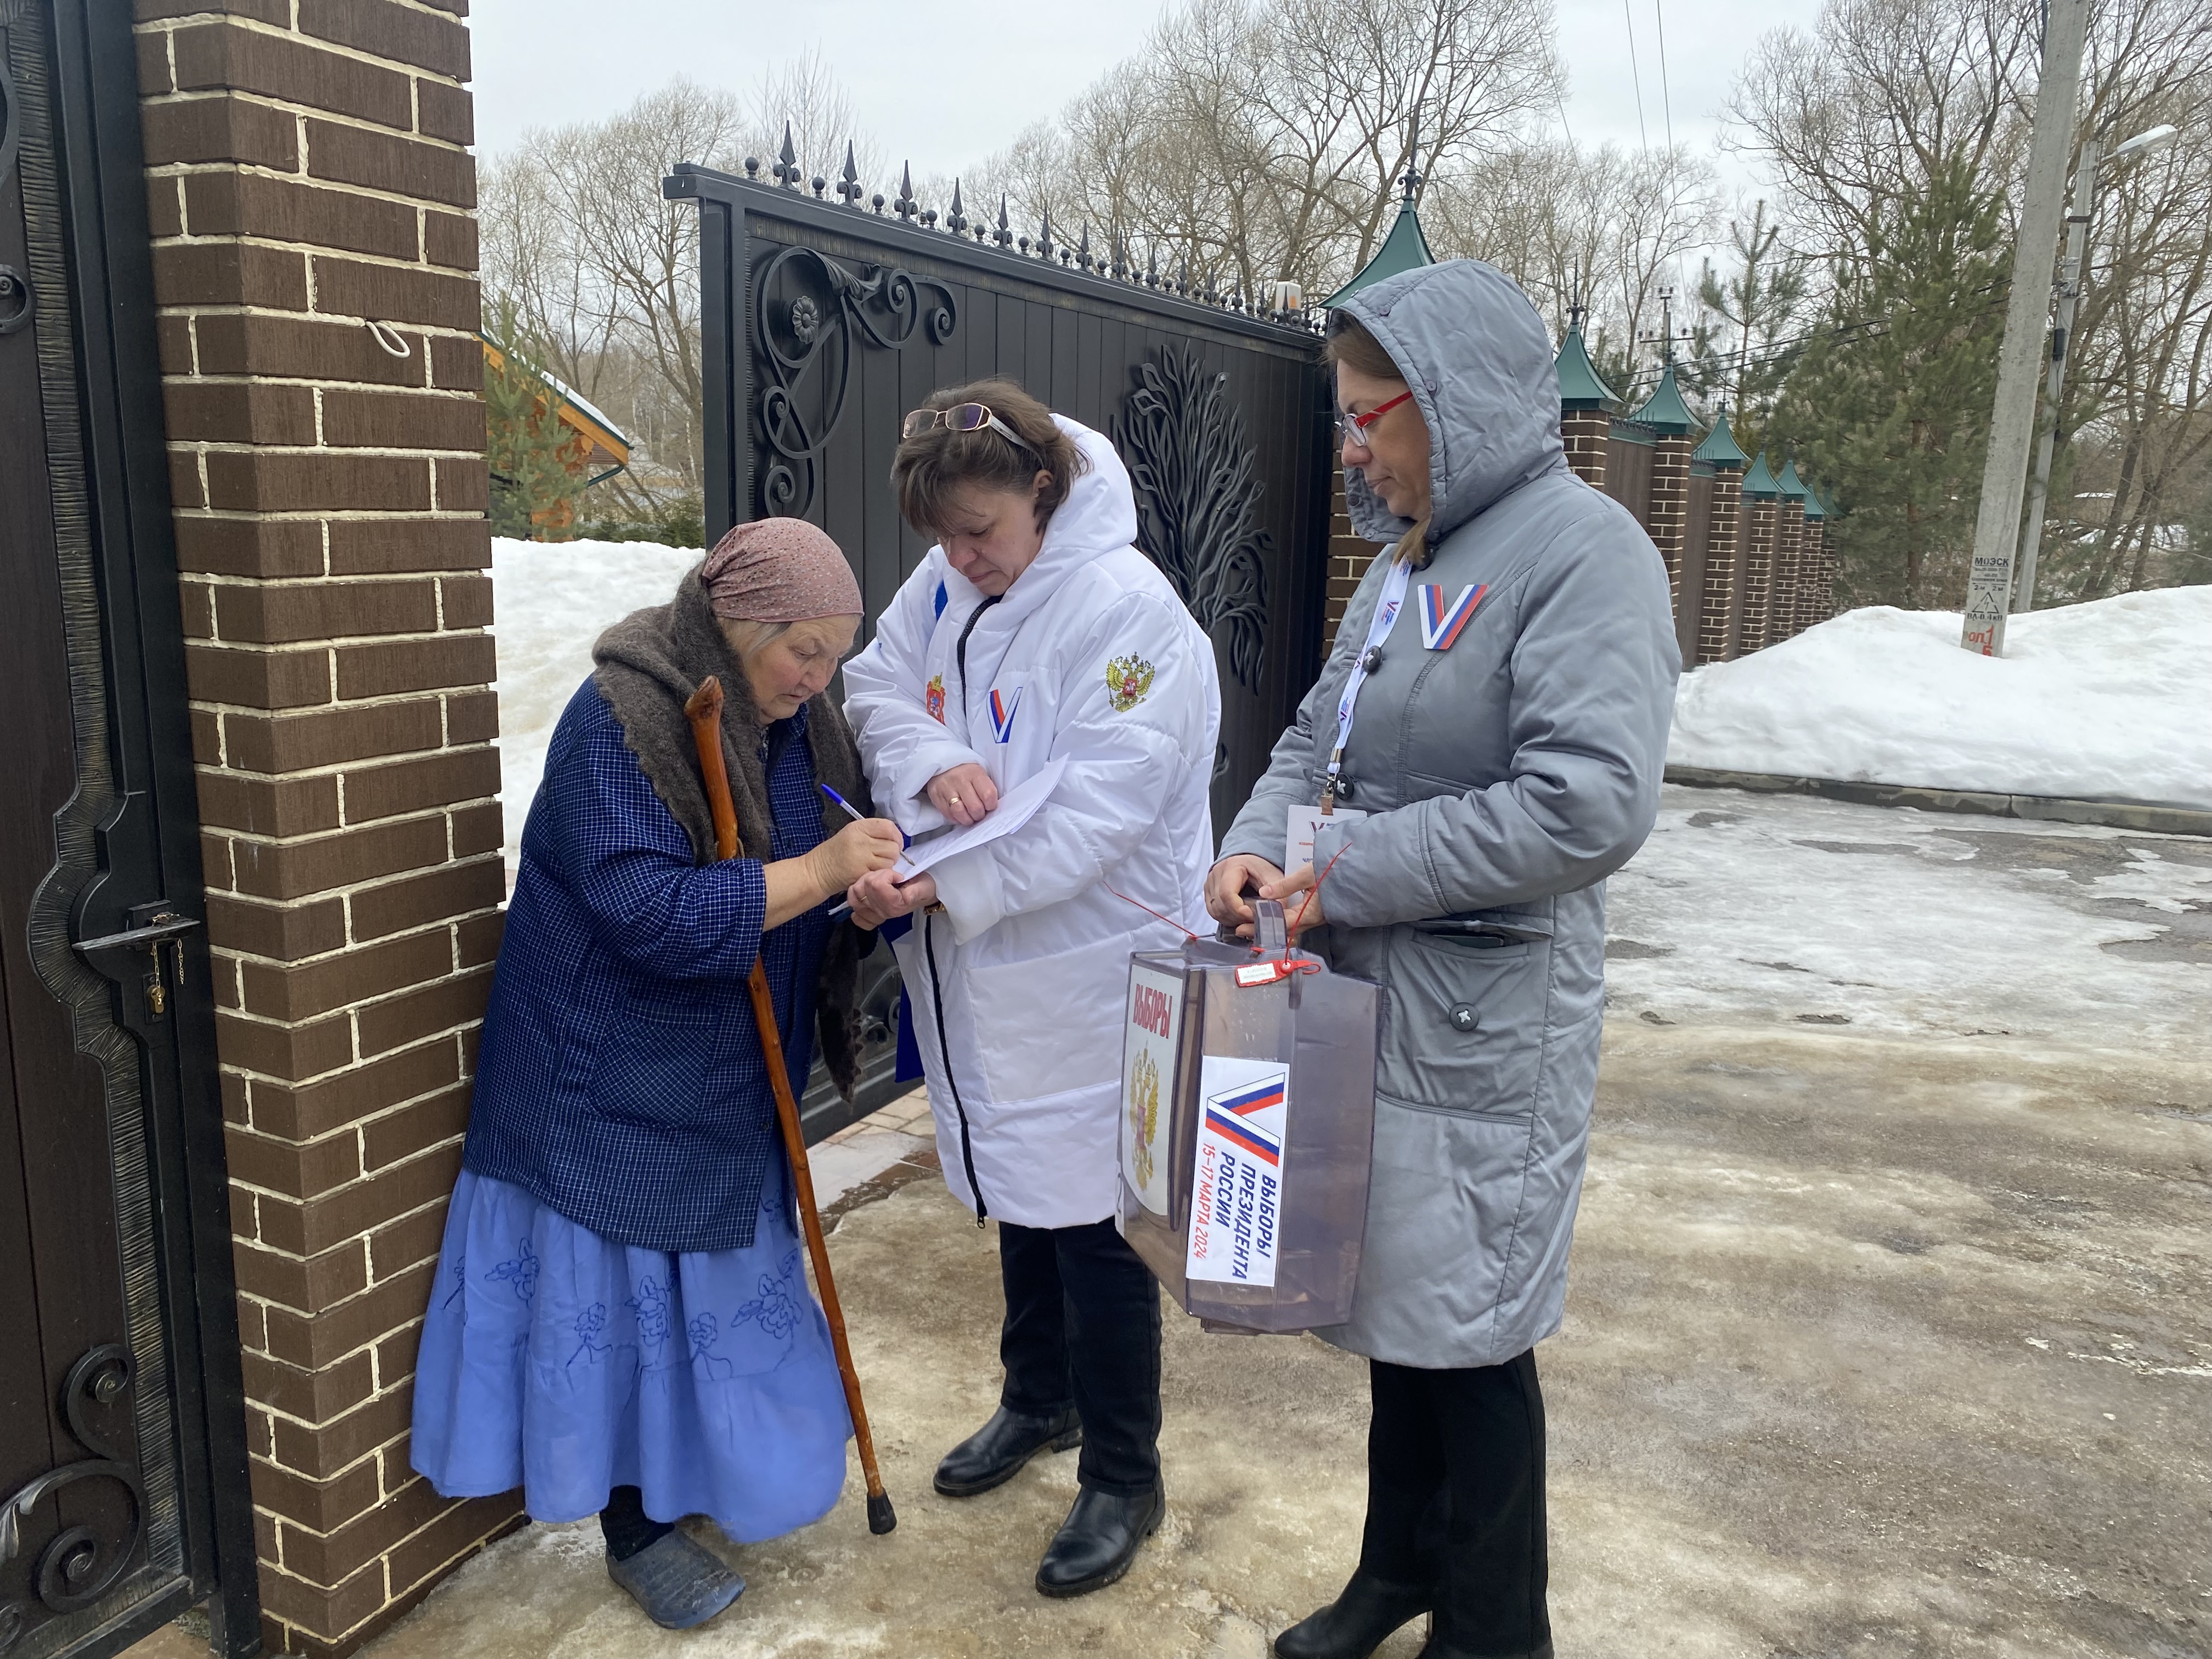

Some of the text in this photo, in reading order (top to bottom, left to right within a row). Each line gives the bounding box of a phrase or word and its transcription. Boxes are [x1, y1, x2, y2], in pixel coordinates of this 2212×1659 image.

[1975, 557, 2009, 566] МОЭСК
[1133, 983, 1172, 1040] ВЫБОРЫ
[1197, 1180, 1212, 1226] МАРТА
[1215, 1151, 1235, 1228] РОССИИ
[1256, 1173, 1277, 1259] ВЫБОРЫ
[1193, 1226, 1209, 1260] 2024
[1232, 1163, 1256, 1280] ПРЕЗИДЕНТА
